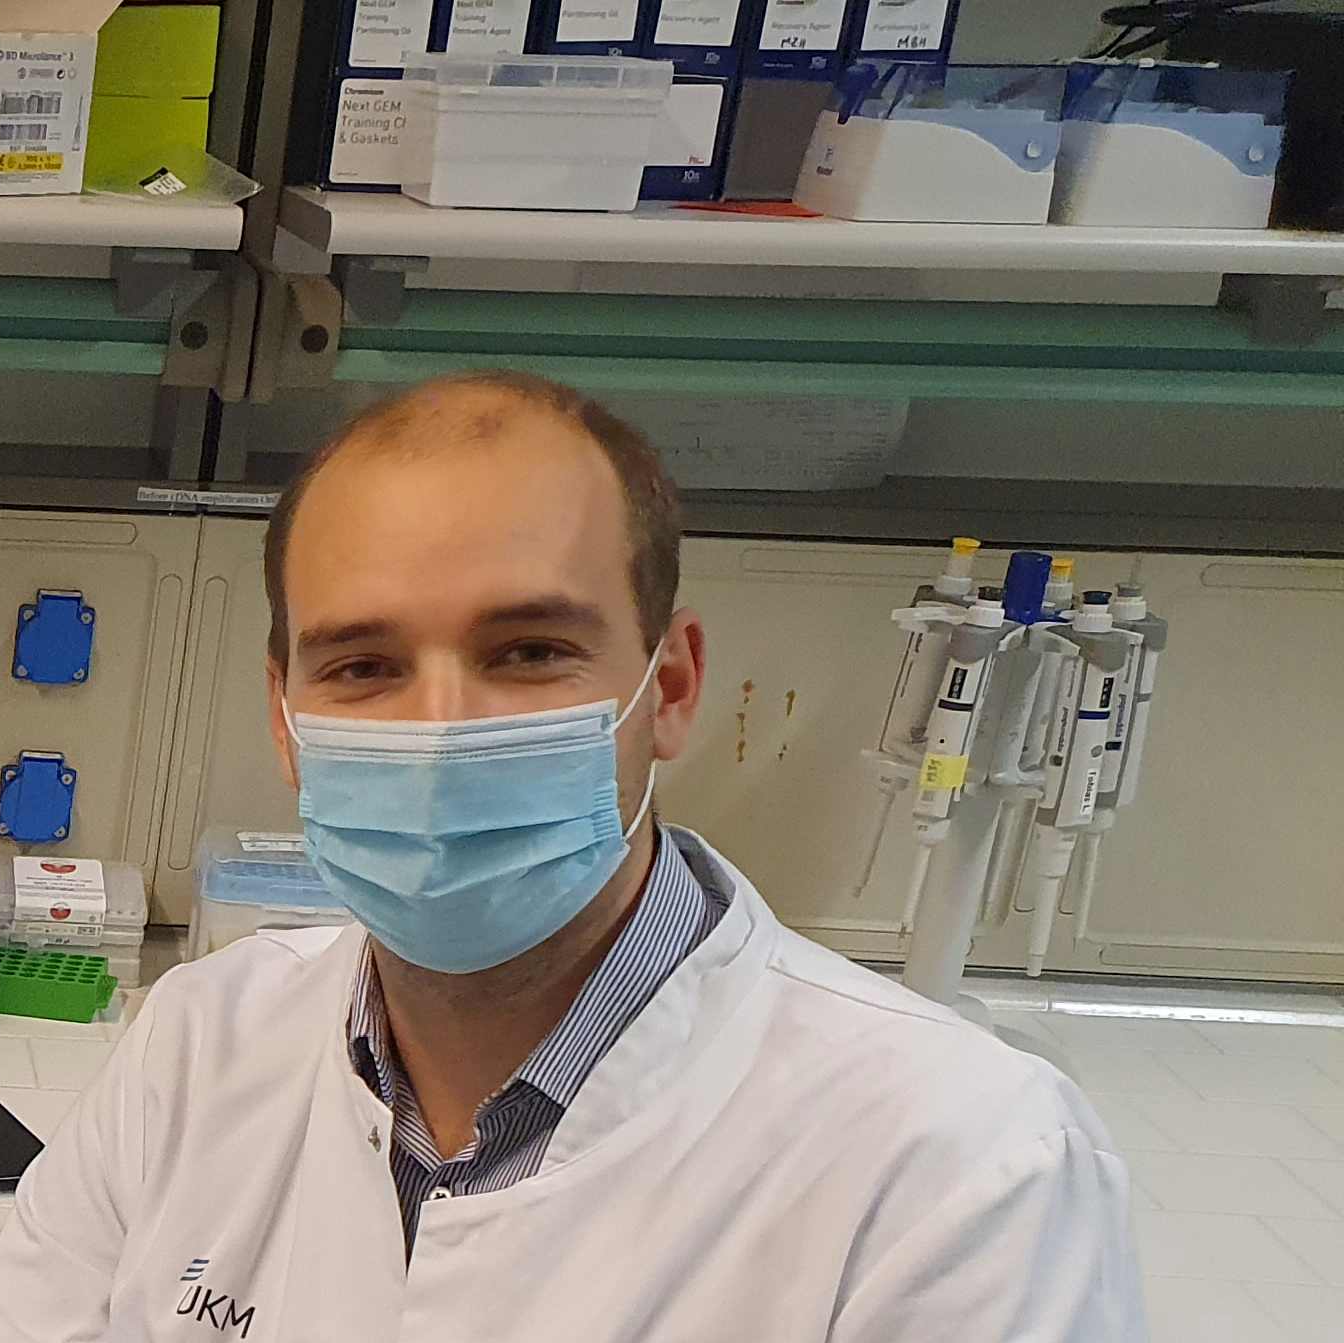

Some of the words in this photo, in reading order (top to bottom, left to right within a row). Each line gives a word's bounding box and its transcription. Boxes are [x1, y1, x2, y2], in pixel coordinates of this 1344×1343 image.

[342, 100, 371, 112] Next
[373, 101, 402, 113] GEM
[341, 116, 390, 131] Training
[350, 132, 399, 146] Gaskets
[176, 1285, 256, 1339] UKM
